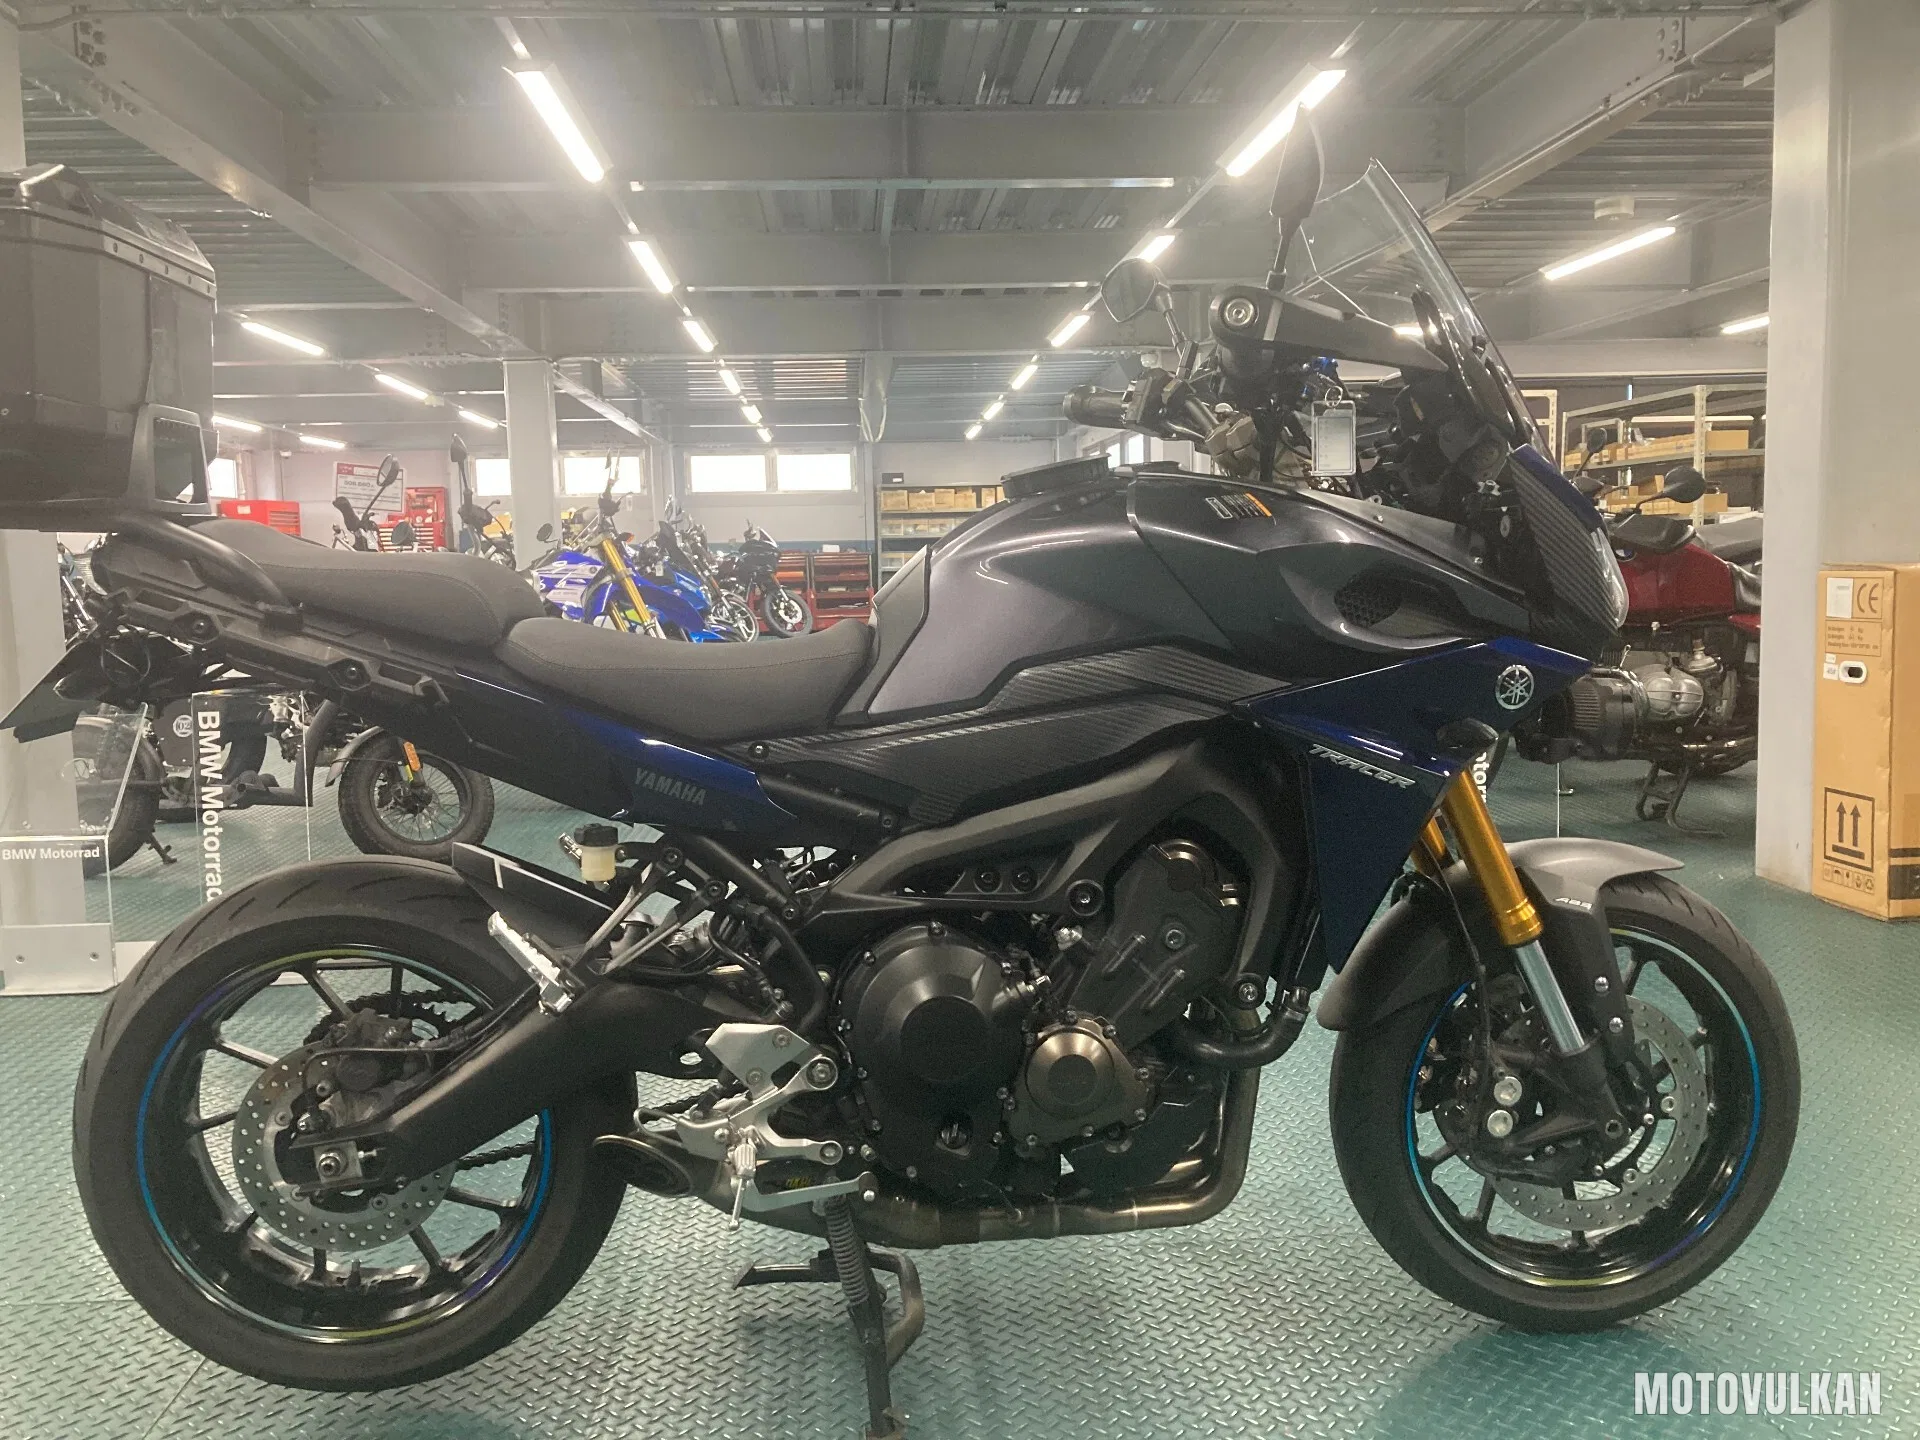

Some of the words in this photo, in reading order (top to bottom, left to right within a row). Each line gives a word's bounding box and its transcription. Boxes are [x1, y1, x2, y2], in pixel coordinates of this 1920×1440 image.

[197, 711, 223, 779] BMW
[1308, 743, 1416, 789] TRACER
[634, 767, 707, 805] YAMAHA
[2, 848, 37, 860] BMW
[39, 846, 100, 859] Motorrad
